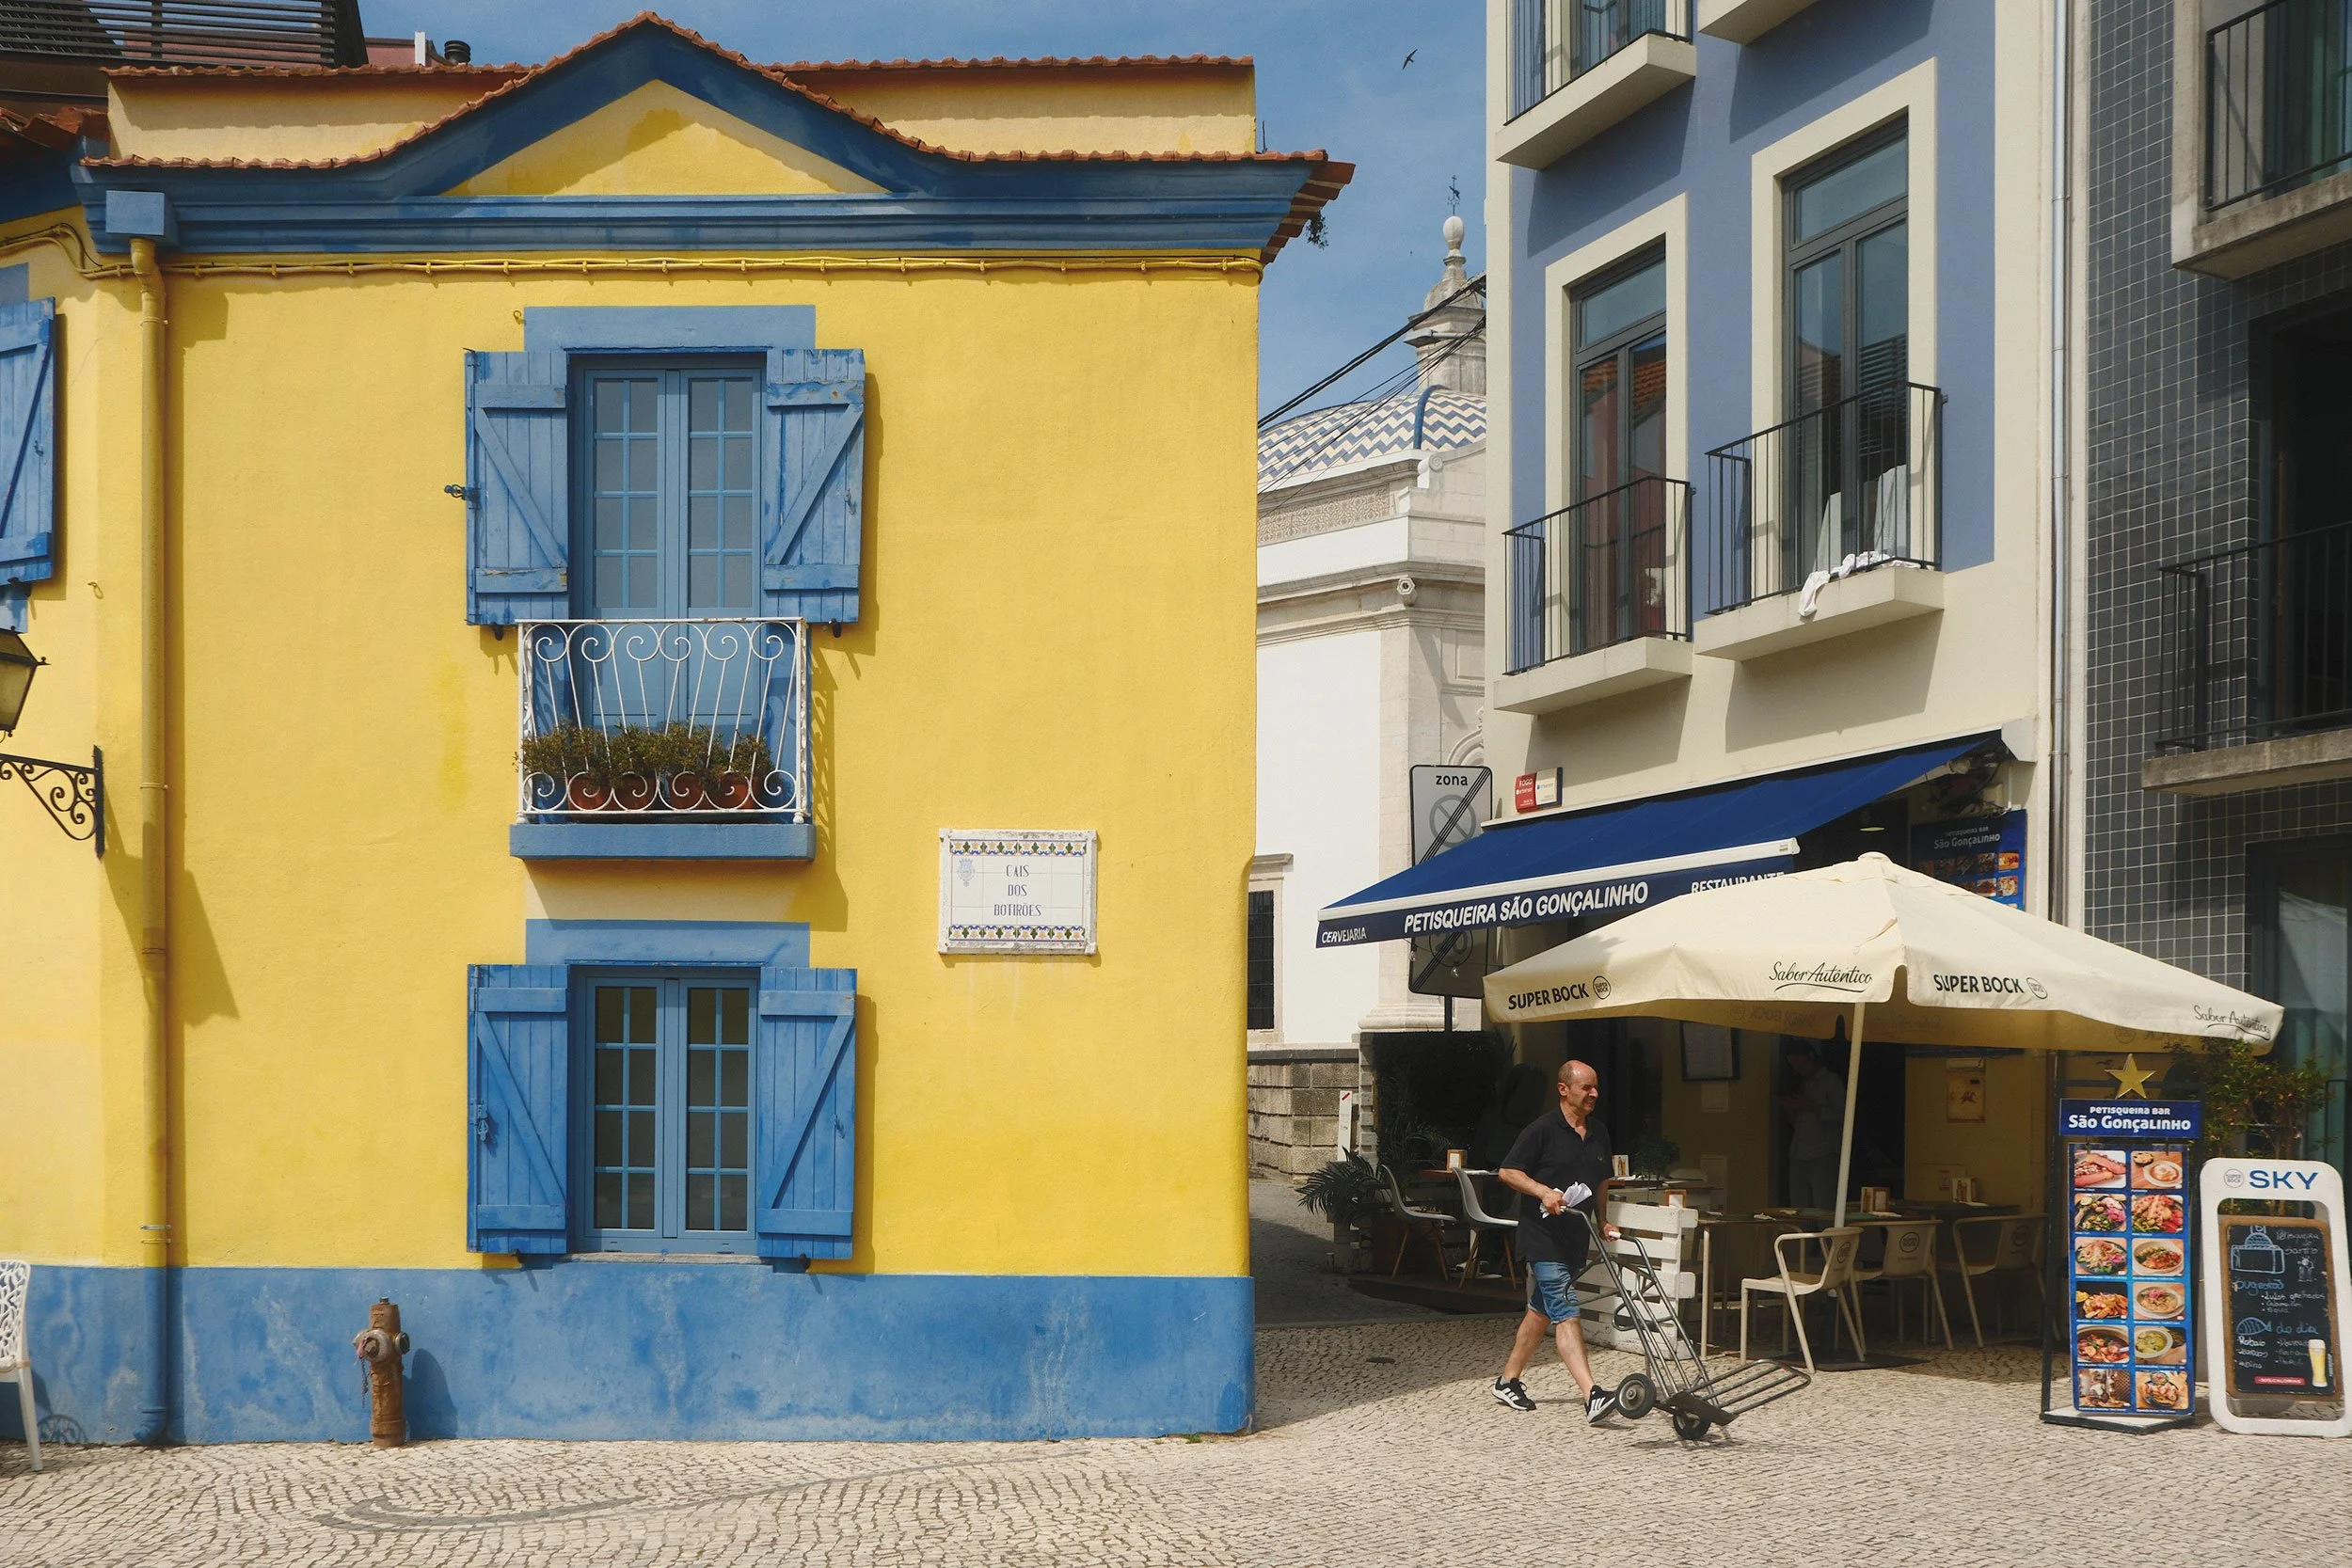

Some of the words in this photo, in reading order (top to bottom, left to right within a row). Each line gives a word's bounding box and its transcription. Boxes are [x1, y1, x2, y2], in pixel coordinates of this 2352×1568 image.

[1436, 775, 1468, 785] zona
[1006, 864, 1029, 877] CAIS
[1008, 884, 1027, 896] DOS
[993, 903, 1041, 916] BOTIRÕES
[1404, 902, 1497, 934] PETISQUEIRA
[1500, 895, 1533, 921] SÃO
[1535, 881, 1648, 917] GONÇALINHO
[1322, 927, 1367, 943] CERVEJARIA
[1769, 961, 1807, 981] Sabor
[1807, 962, 1873, 984] Autêntico
[1933, 974, 1979, 992] SUPER
[1980, 976, 2025, 993] BOCK
[1508, 990, 1551, 1010] SUPER
[1551, 983, 1590, 1004] BOCK
[2193, 1005, 2227, 1023] Sabor
[2069, 1115, 2098, 1128] São
[2249, 1170, 2318, 1190] SKY
